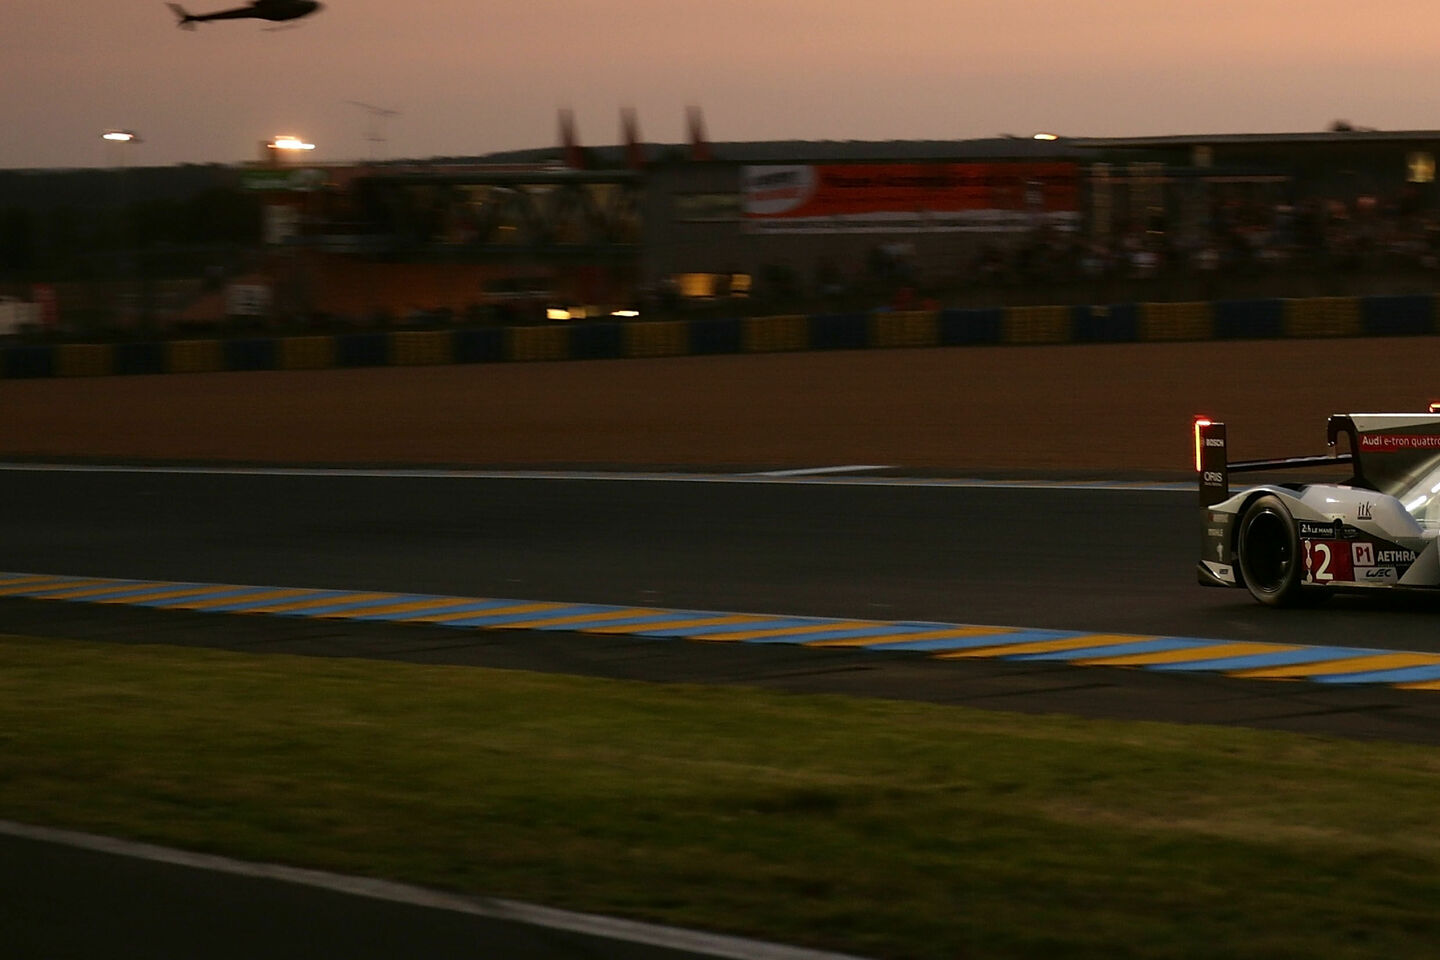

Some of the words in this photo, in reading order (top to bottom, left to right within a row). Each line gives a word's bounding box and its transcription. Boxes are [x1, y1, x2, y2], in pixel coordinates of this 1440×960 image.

[1206, 438, 1224, 447] BOSCH
[1362, 436, 1382, 446] Audi
[1384, 436, 1409, 446] e-tron
[1204, 471, 1223, 482] ORIS
[1355, 546, 1371, 563] P1
[1377, 550, 1417, 562] AETHRA
[1314, 543, 1334, 580] 2
[1366, 568, 1393, 578] WEC
